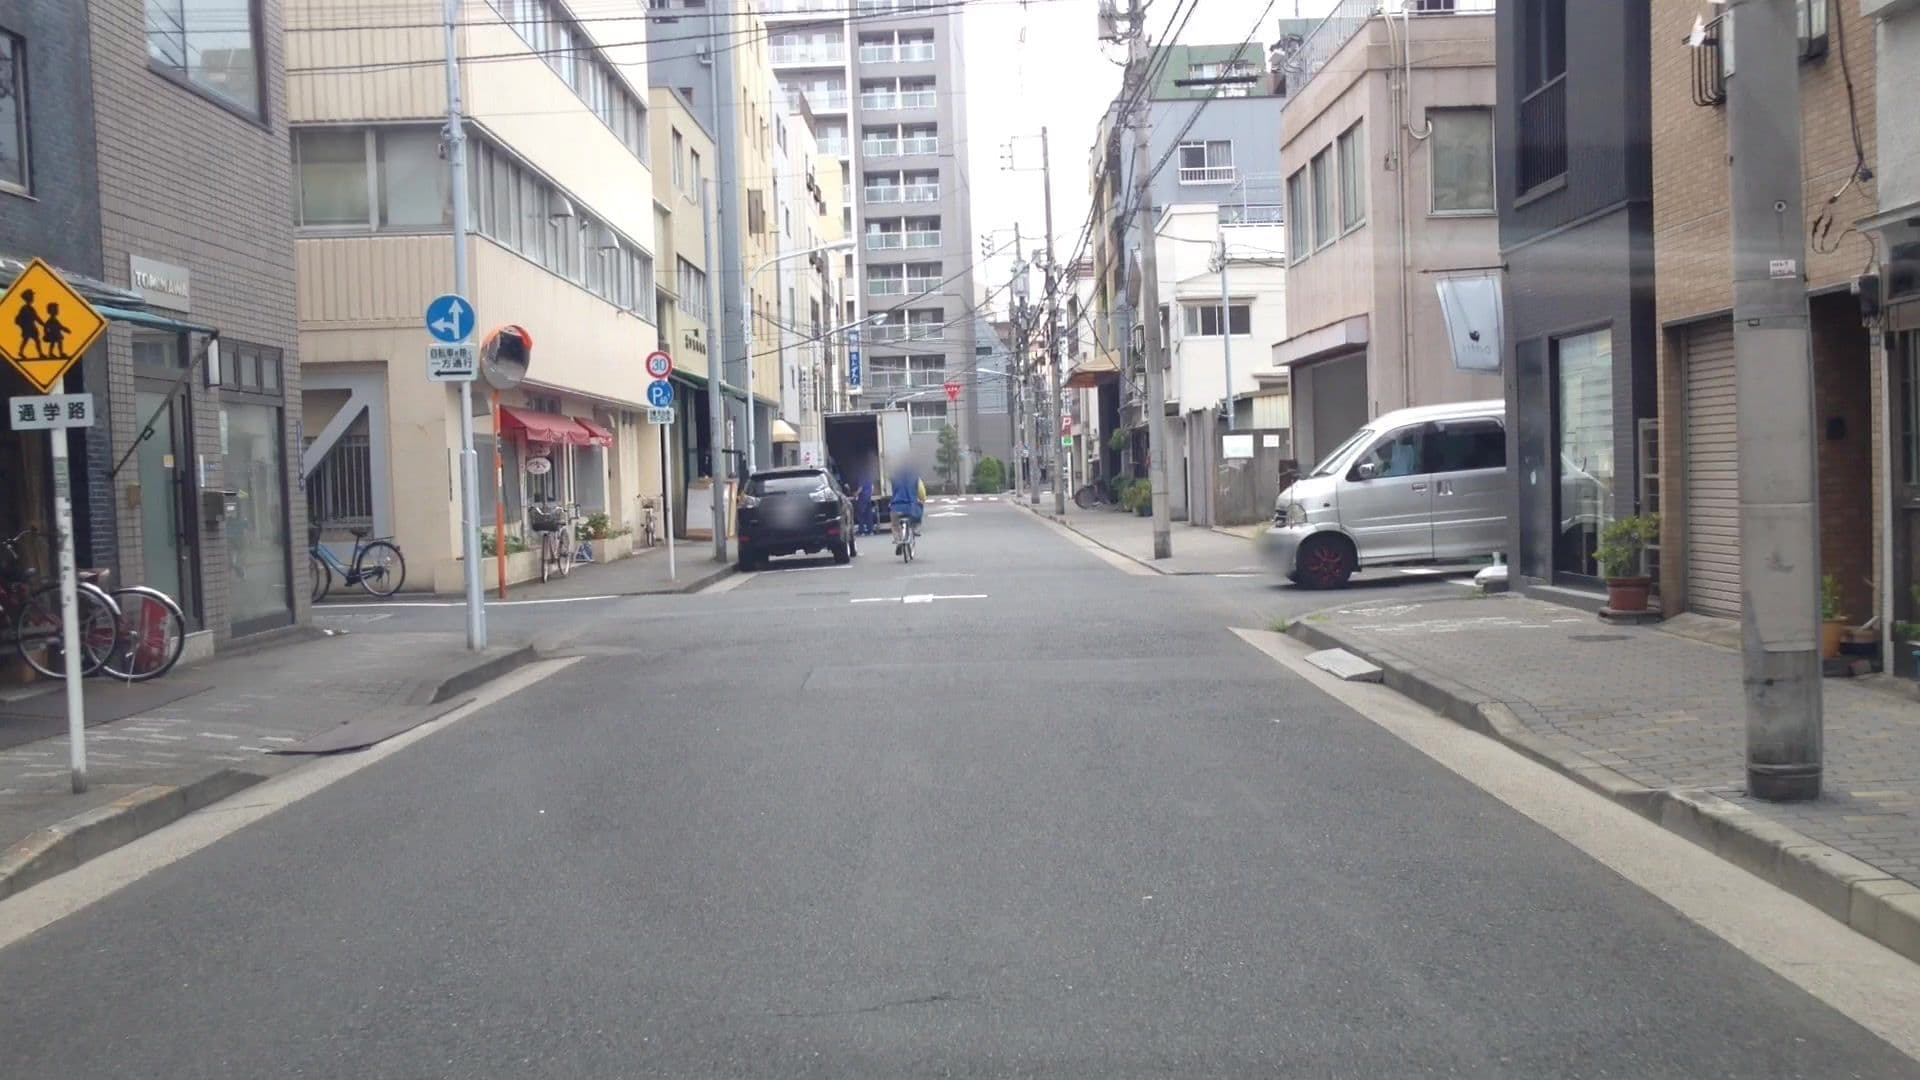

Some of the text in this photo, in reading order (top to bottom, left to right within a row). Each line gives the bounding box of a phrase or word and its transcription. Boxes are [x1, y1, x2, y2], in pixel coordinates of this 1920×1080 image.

[431, 359, 473, 369] 一方通行
[651, 358, 667, 372] 30
[652, 386, 663, 405] P
[18, 401, 86, 422] 通学路
